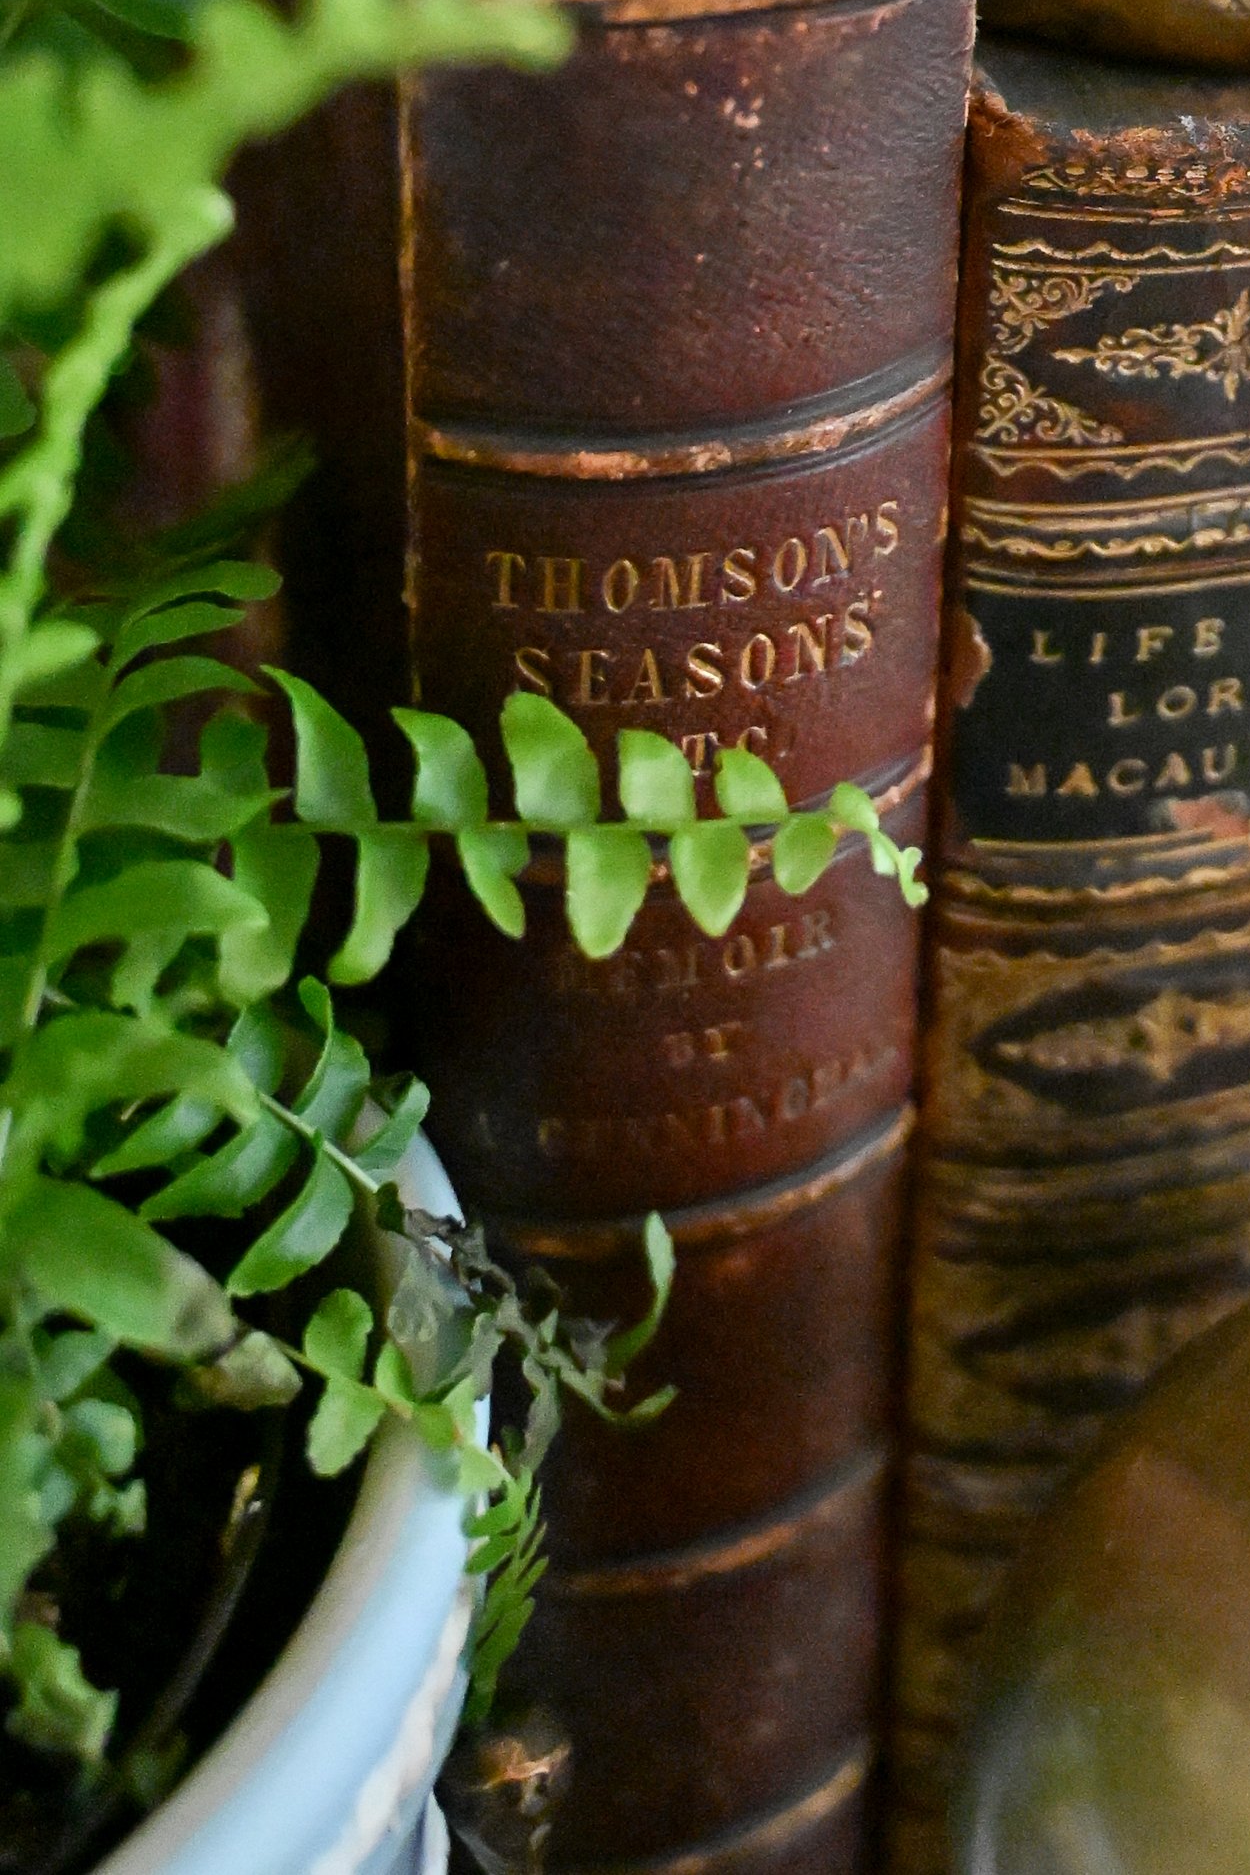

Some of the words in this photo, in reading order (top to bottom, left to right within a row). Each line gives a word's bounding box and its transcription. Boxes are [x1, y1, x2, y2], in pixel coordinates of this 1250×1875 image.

[485, 499, 899, 614] THOMSON'S
[513, 599, 874, 706] SEASONS
[1029, 617, 1226, 666] LIFE
